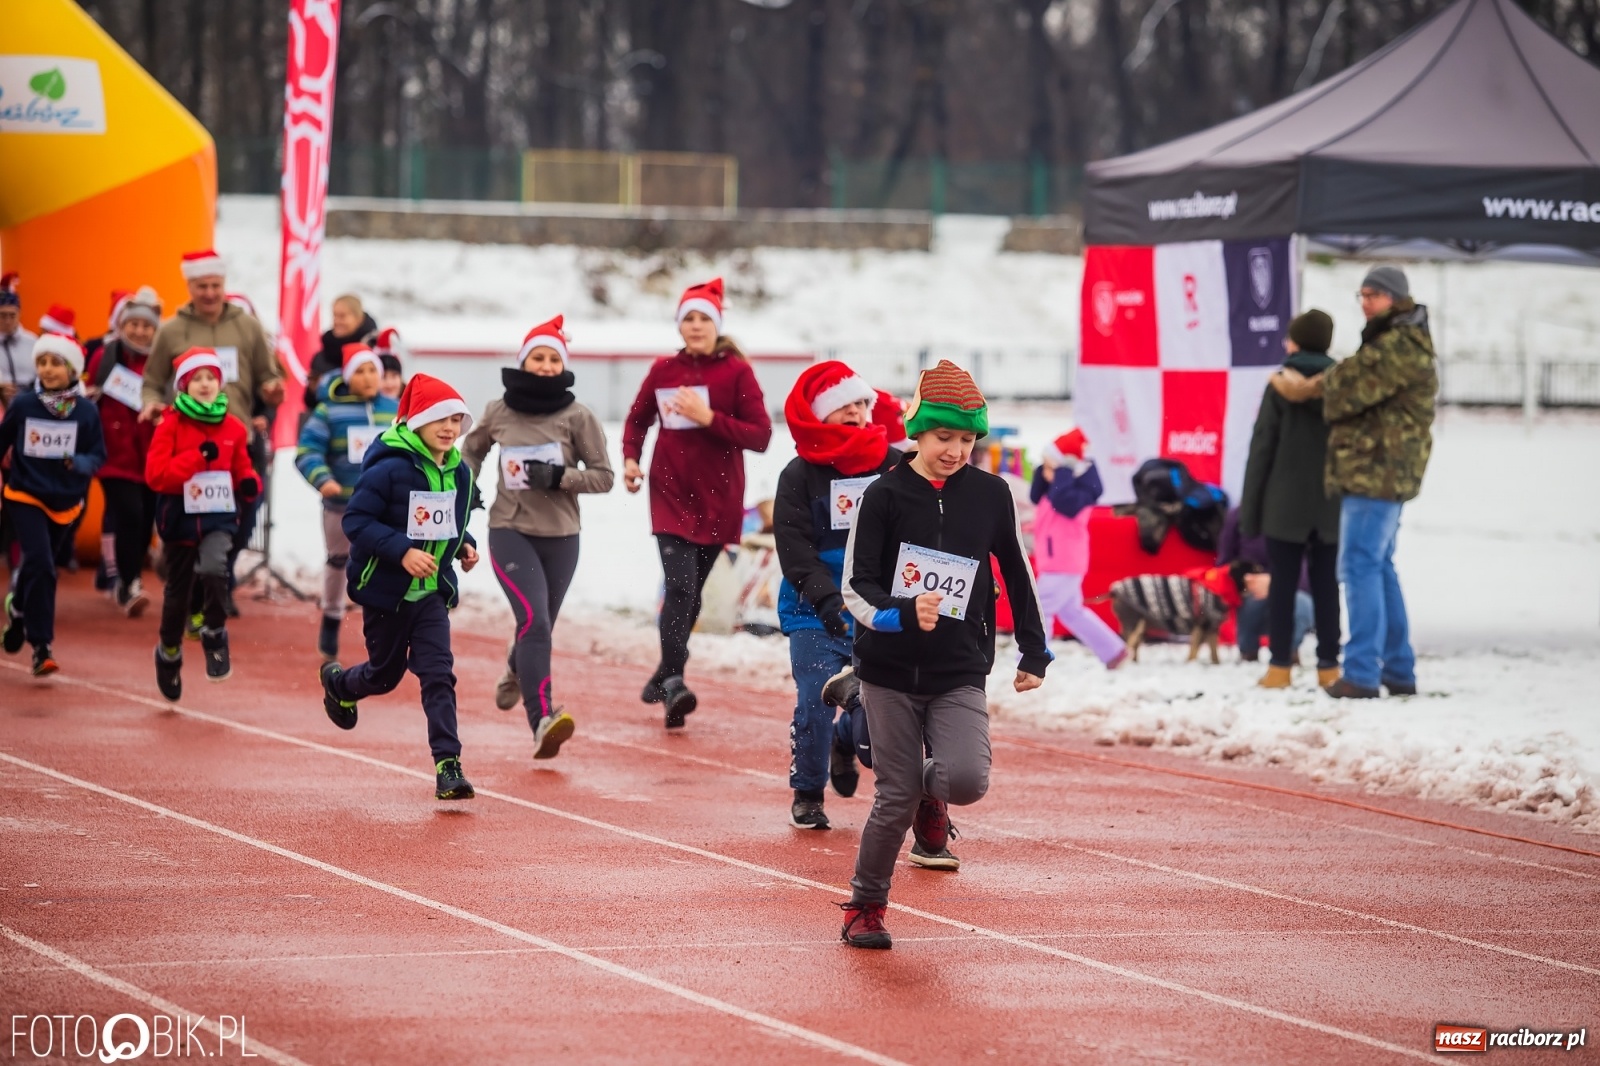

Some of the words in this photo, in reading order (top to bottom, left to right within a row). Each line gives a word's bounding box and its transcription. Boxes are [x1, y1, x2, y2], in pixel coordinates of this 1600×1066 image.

[42, 432, 72, 448] 047
[204, 484, 230, 499] 070
[923, 571, 967, 599] 042
